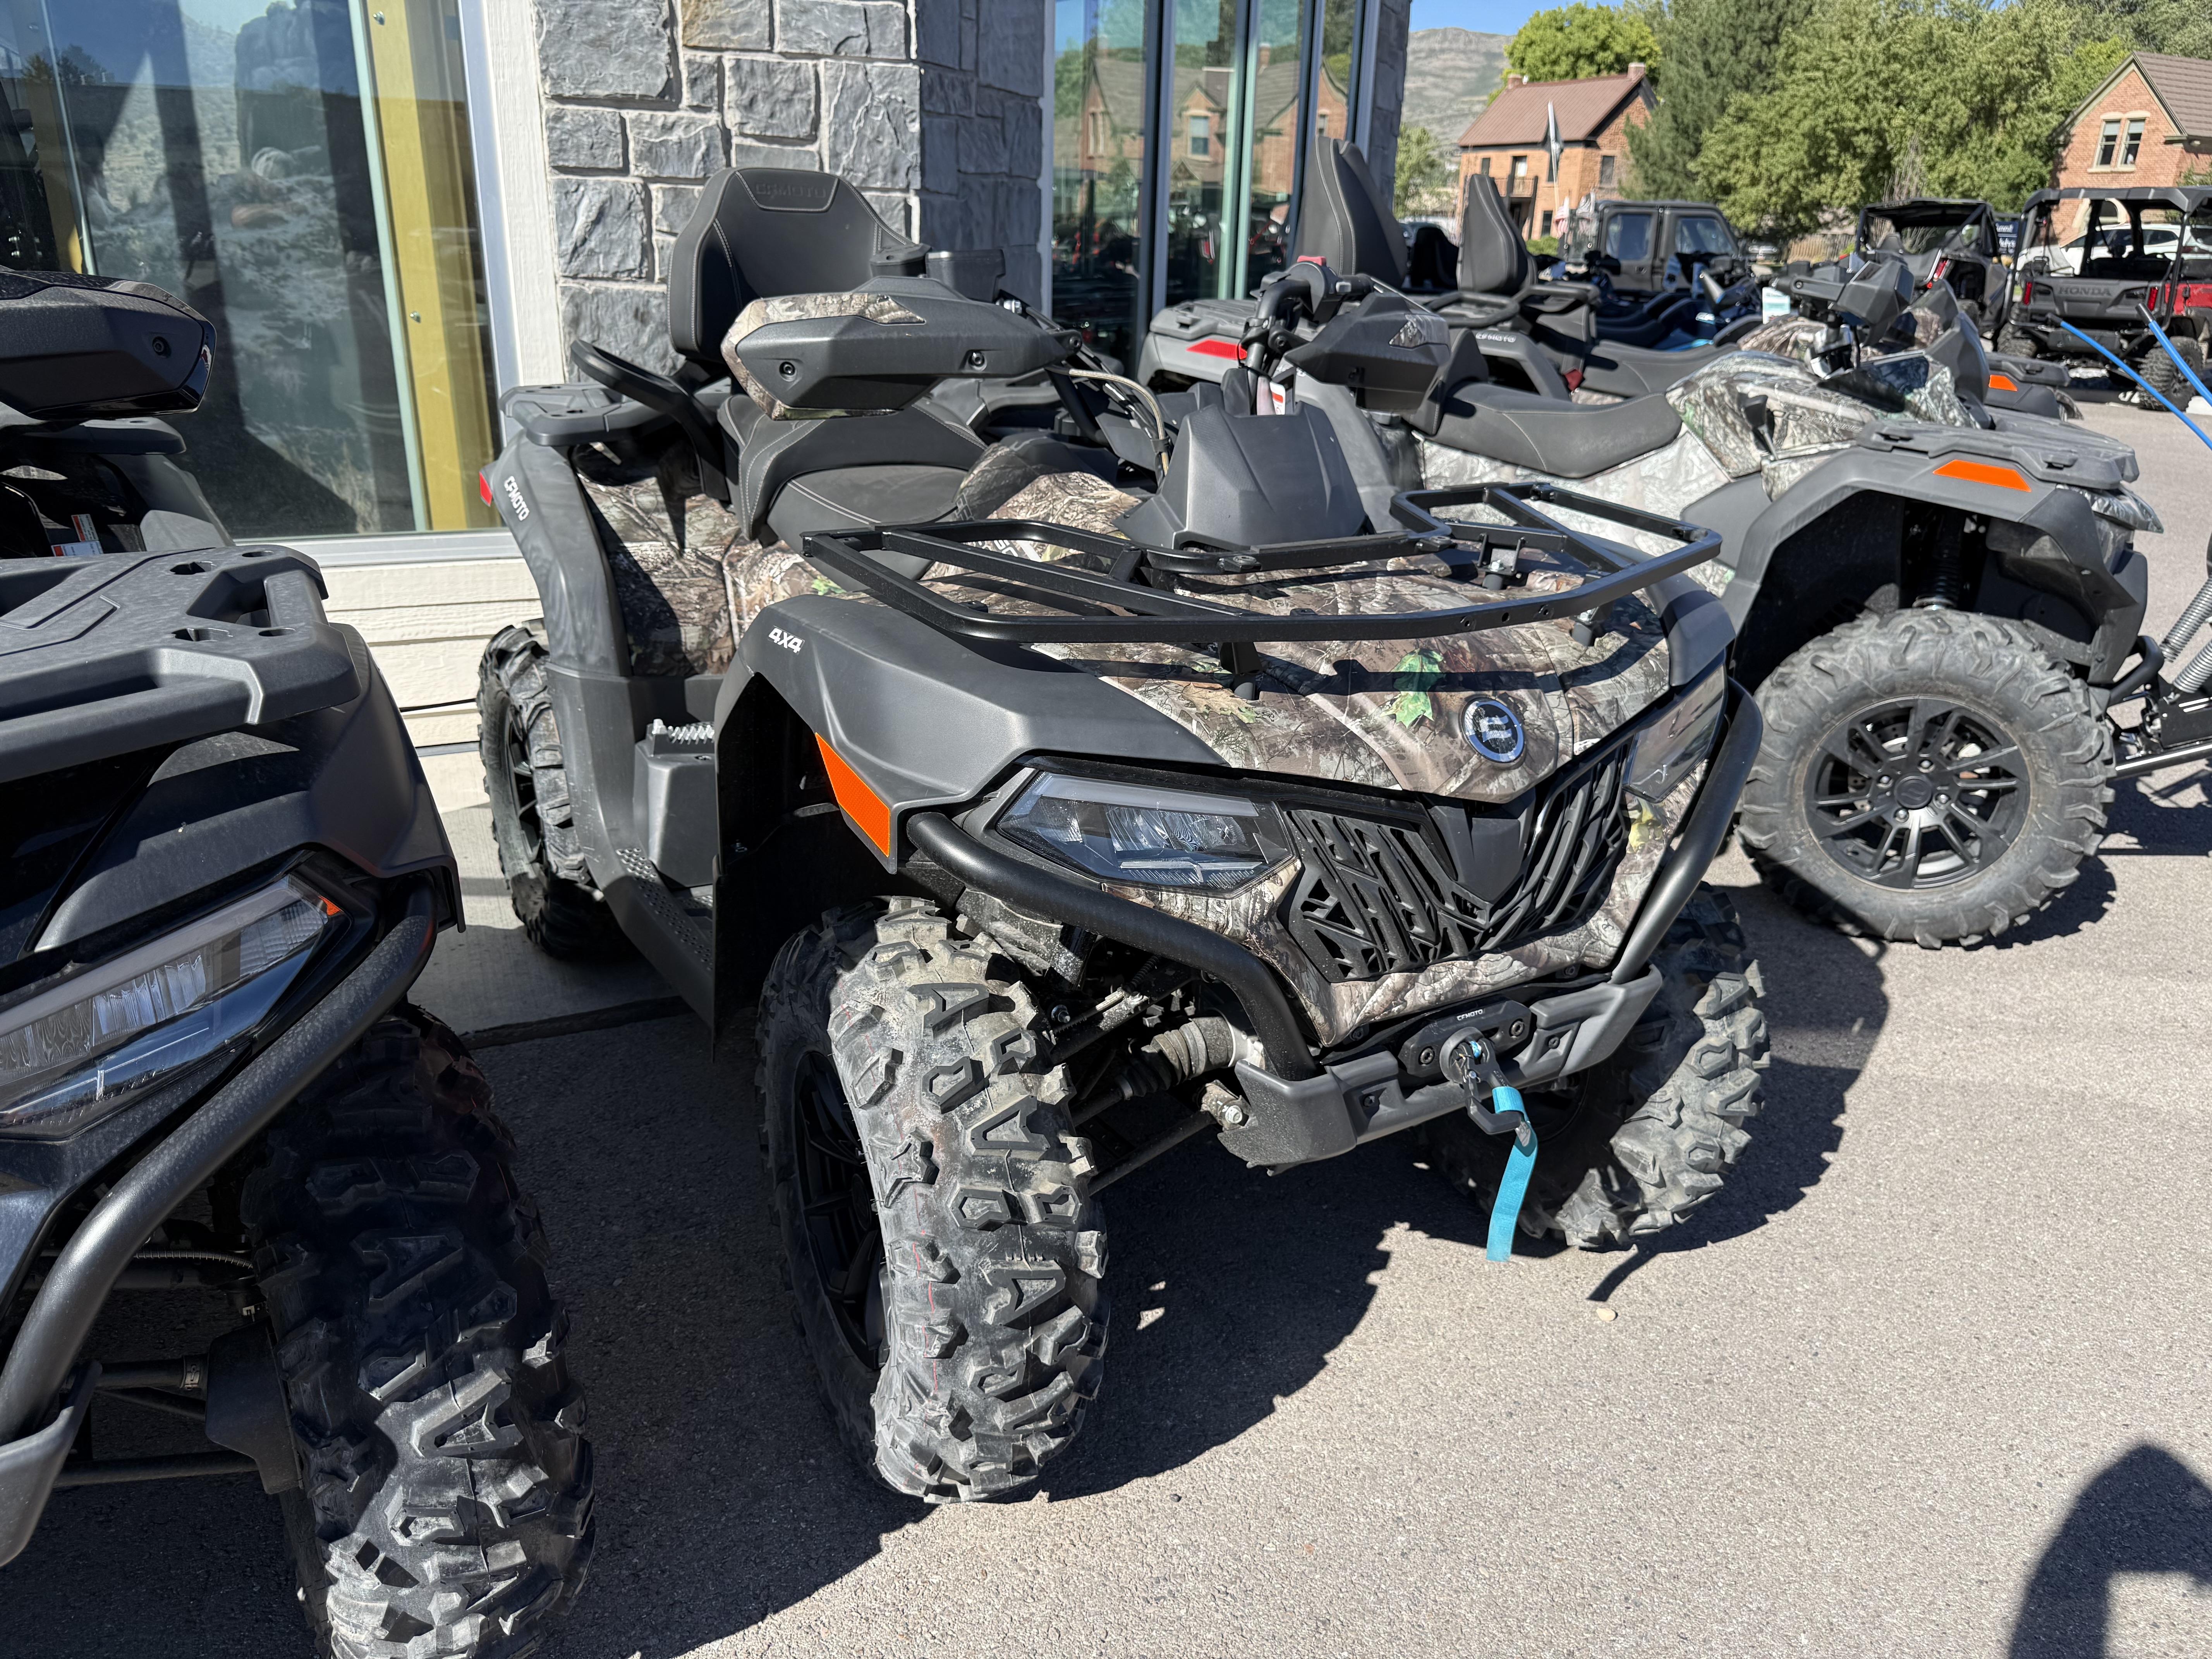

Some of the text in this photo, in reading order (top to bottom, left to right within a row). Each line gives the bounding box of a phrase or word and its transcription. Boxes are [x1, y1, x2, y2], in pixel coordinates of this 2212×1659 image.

[756, 183, 826, 198] CFMOTO
[2058, 286, 2112, 296] HONDA
[1475, 333, 1516, 342] CFMOTO
[504, 476, 530, 521] CFMOTO
[768, 628, 803, 653] 4X4
[1456, 1009, 1483, 1021] CFMOTO
